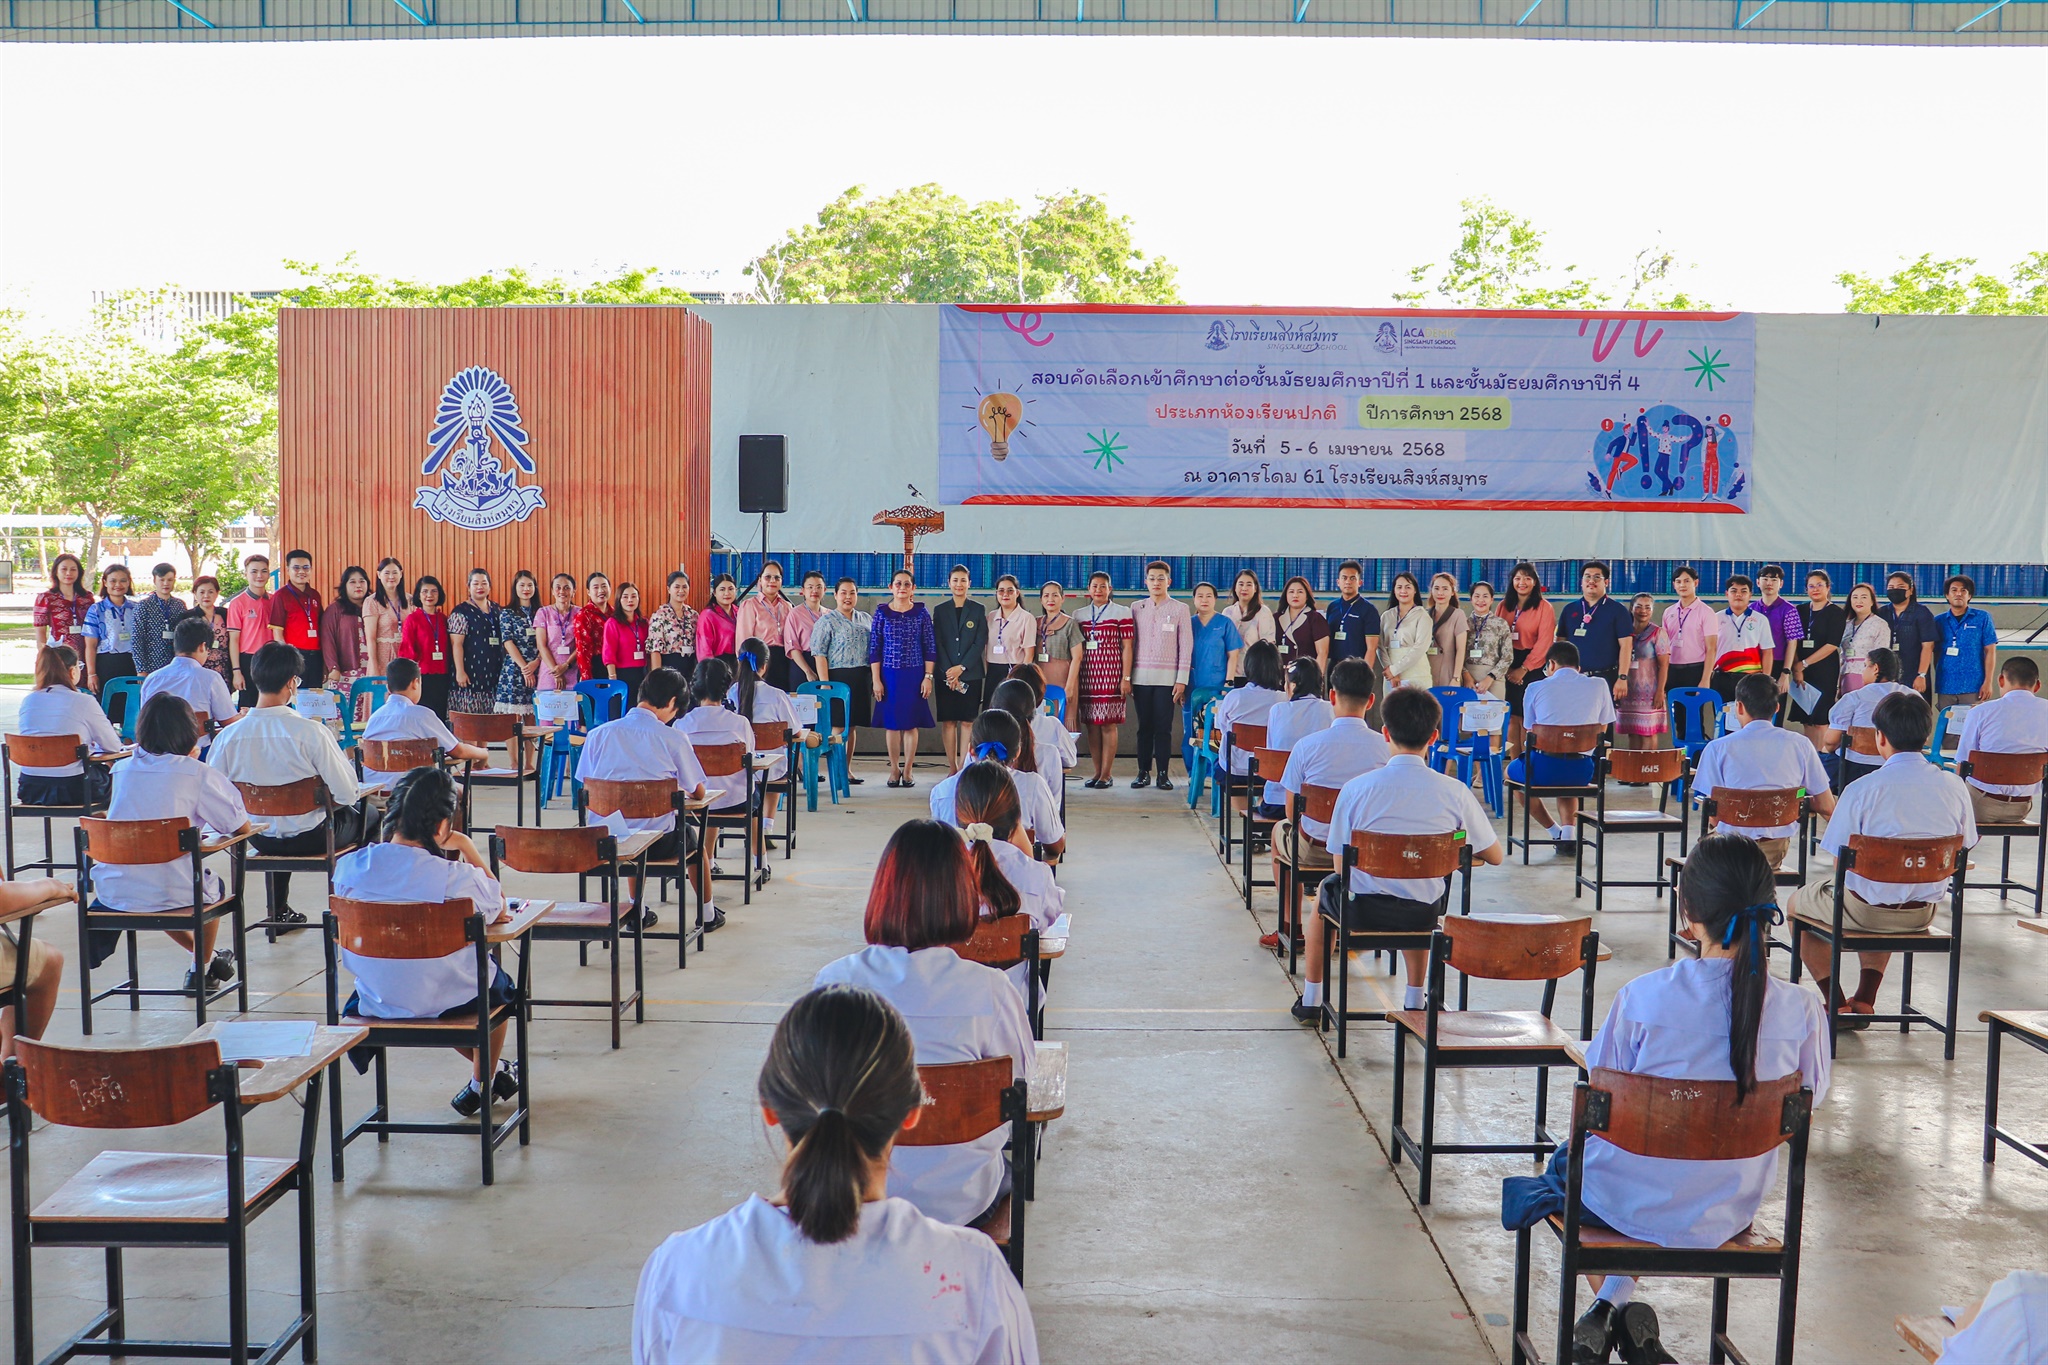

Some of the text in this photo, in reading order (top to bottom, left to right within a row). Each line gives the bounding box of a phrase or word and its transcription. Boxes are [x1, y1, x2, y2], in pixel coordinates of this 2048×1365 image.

[1403, 328, 1457, 339] ACADEMIC
[1031, 364, 1641, 391] สอบคัดเลือกเข้าศึกษาต่อชั้นมัธยมศึกษาปีที่ 1 และชั้นมัธยมศึกษาปีที่ 4
[1155, 402, 1337, 421] ประเภทห้องเรียนปกติ
[1366, 403, 1503, 421] ปีการศึกษา 2568
[1231, 434, 1266, 454] วันที่
[1280, 440, 1291, 455] 5
[1308, 441, 1318, 455] 6
[1328, 443, 1393, 456] เมษายน
[1402, 442, 1446, 457] 2568
[1184, 463, 1488, 492] ณ อาคารโดม 61 โรงเรียนสิงห์สมุทร
[439, 496, 519, 526] โรงเรียนสิงห์สมุทร
[1641, 765, 1659, 773] 1615
